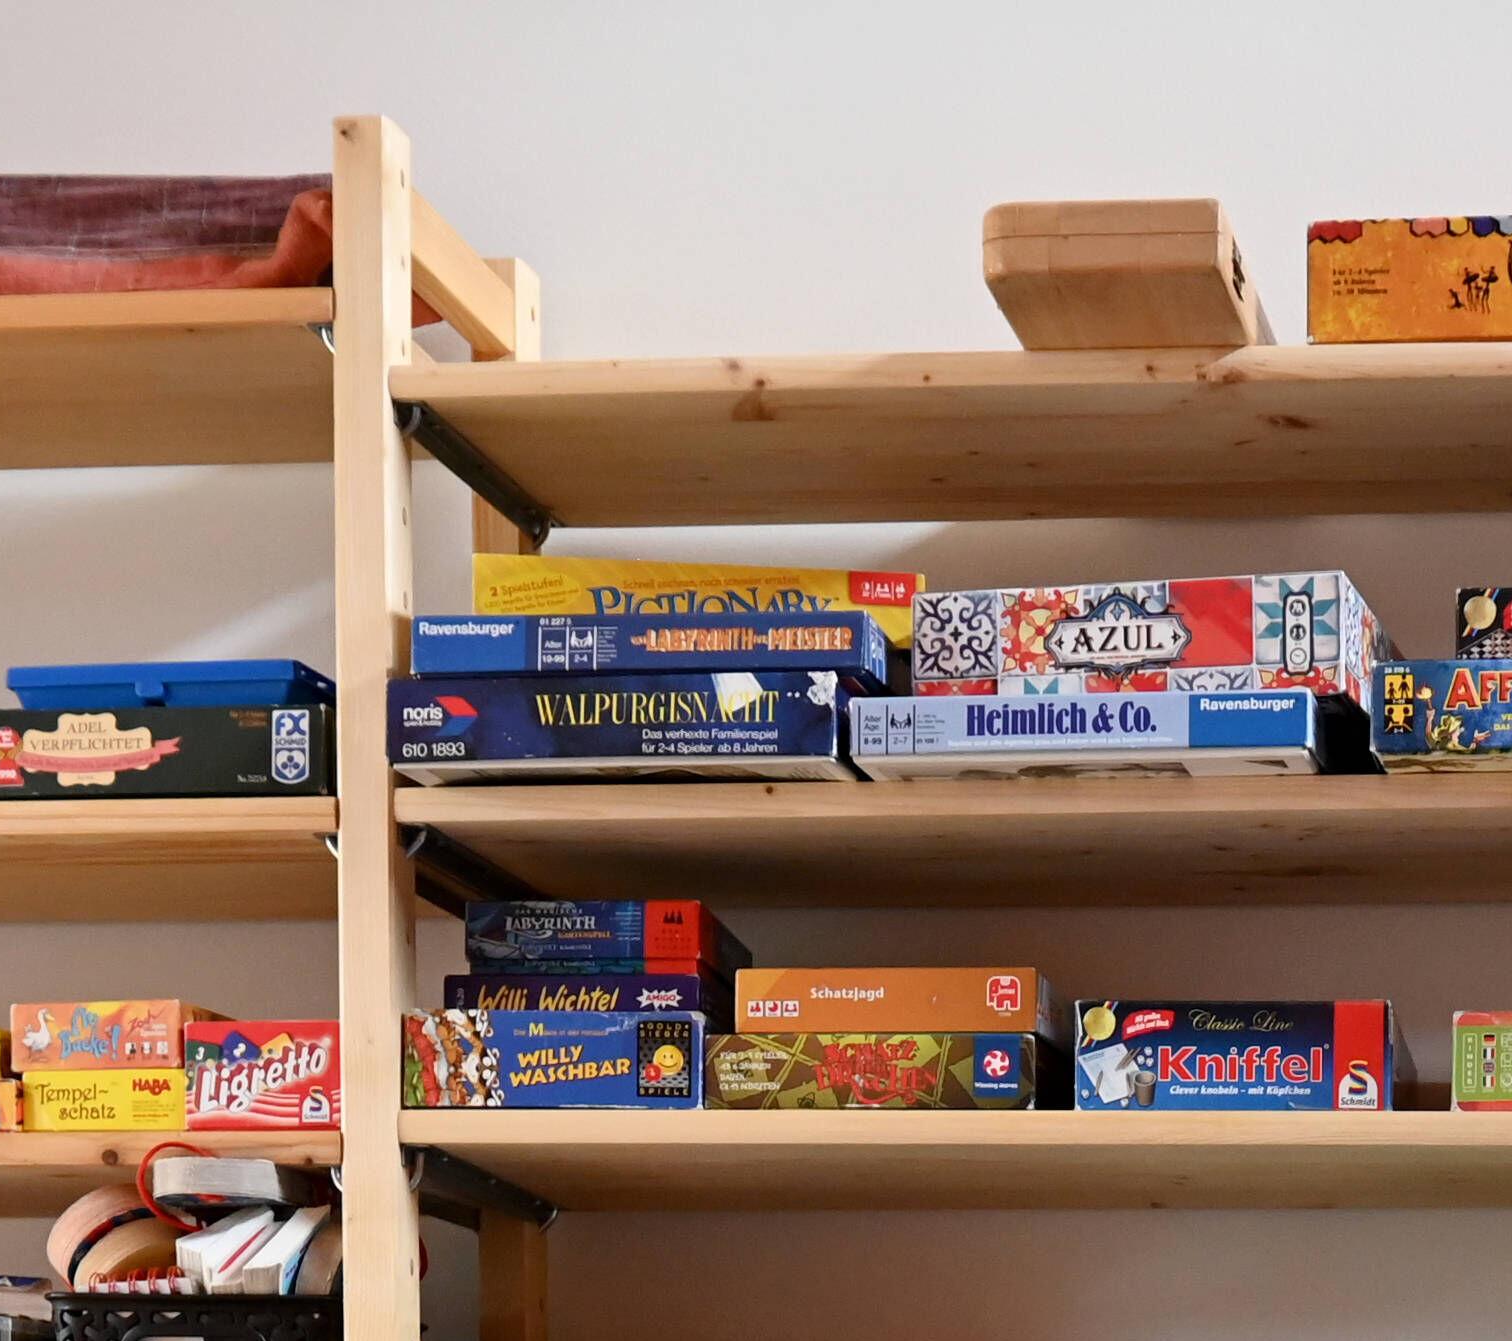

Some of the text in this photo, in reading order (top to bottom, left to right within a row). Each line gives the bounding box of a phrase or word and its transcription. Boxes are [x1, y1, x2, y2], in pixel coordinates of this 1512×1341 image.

[419, 622, 514, 635] Ravensburger
[1071, 625, 1164, 654] AZUL
[536, 691, 778, 725] WALPURGISNACHT
[1200, 697, 1295, 712] Ravensburger
[403, 705, 443, 721] noris
[966, 703, 1156, 736] Heimlich & Co.
[66, 721, 106, 736] ADEL
[642, 729, 778, 741] Das verhexte Familienspiel
[30, 737, 143, 751] VERPFLICHTET
[402, 743, 464, 757] 610 1893
[478, 985, 619, 1011] Willi Wichtel
[518, 1046, 583, 1067] WILLY
[1158, 1047, 1322, 1082] Kniffel
[199, 1043, 326, 1111] Ligretto
[132, 1078, 171, 1094] HABA
[60, 1104, 116, 1120] schatz
